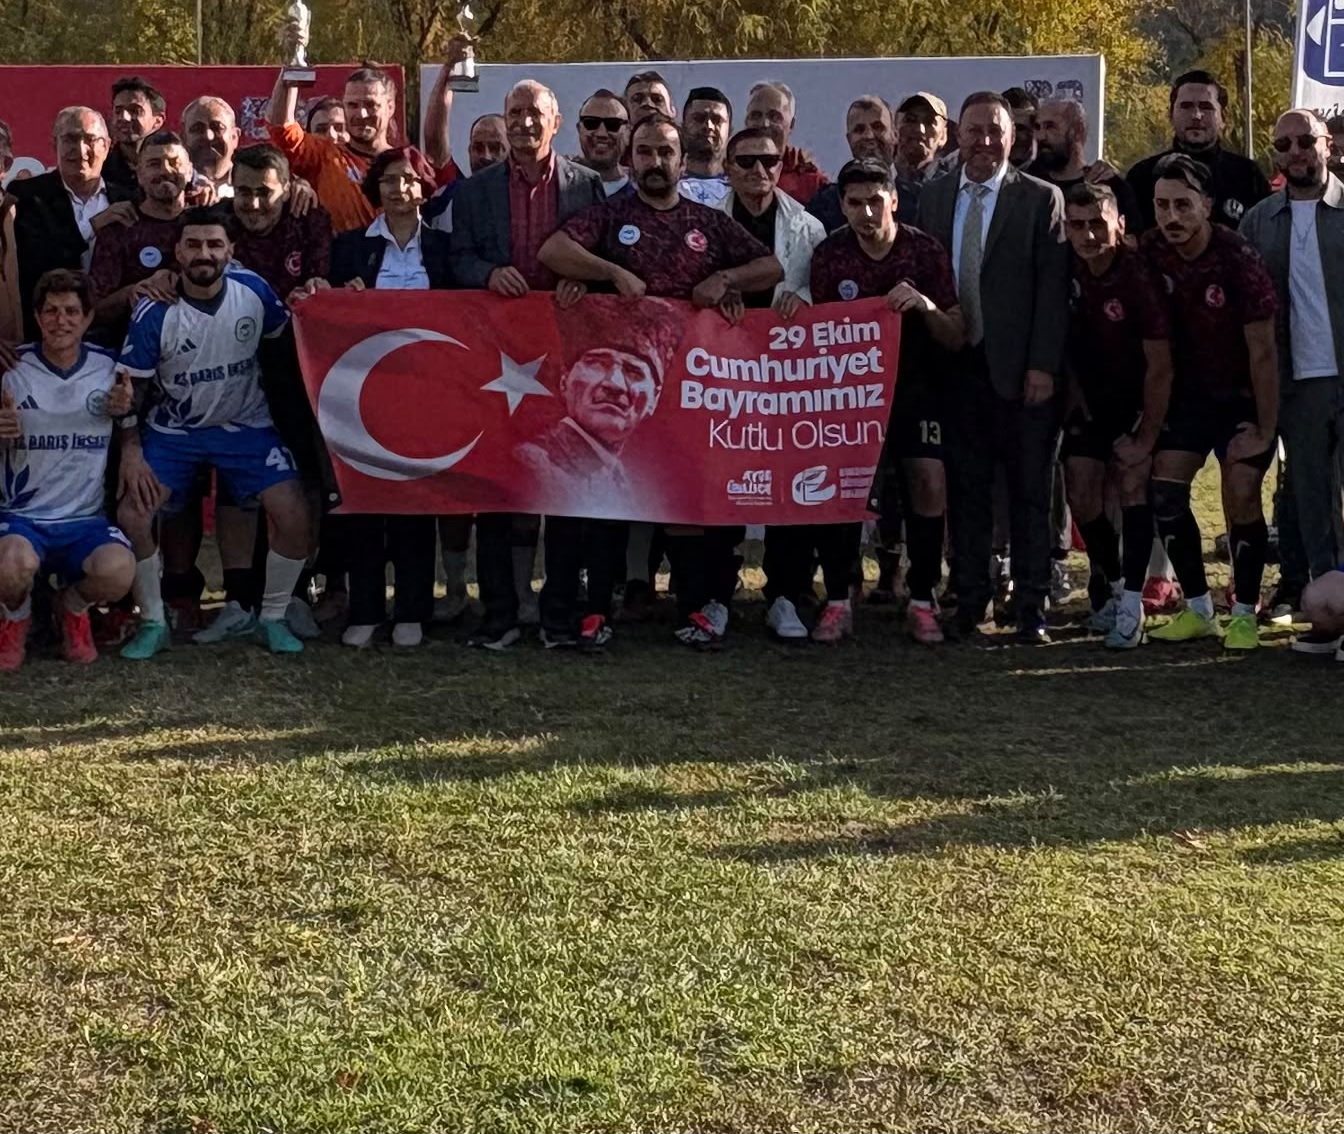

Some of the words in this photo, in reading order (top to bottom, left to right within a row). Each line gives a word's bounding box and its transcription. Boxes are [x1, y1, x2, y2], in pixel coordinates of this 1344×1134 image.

[769, 325, 806, 351] 29
[812, 316, 881, 347] Ekim
[685, 346, 885, 384] Cumhuriyet
[680, 379, 886, 419] Bayramımız
[709, 417, 784, 451] Kutlu
[792, 417, 885, 450] Olsun
[919, 420, 942, 444] 13
